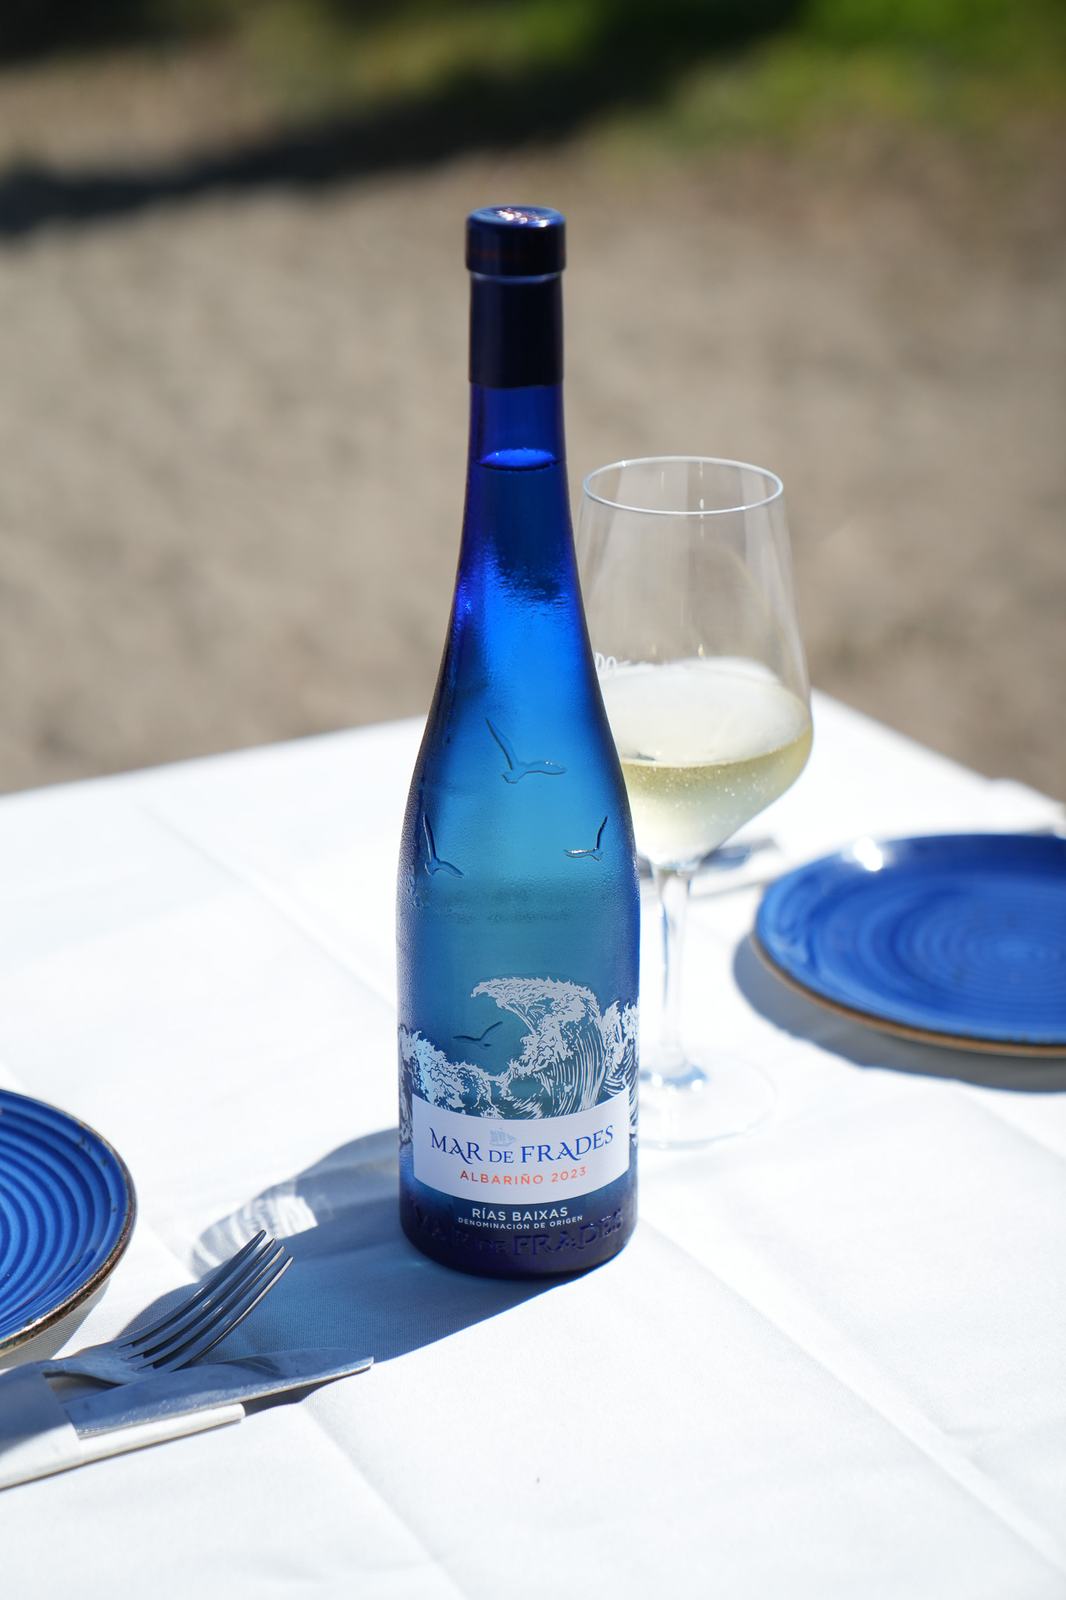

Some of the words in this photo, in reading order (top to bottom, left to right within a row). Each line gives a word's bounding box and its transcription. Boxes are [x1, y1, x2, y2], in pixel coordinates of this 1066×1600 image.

[429, 1127, 484, 1165] MAR
[488, 1150, 515, 1164] DE
[520, 1124, 614, 1164] FRADES
[459, 1170, 544, 1186] ALBARIÑO
[551, 1165, 587, 1183] 2023
[472, 1207, 507, 1221] RÍAS
[512, 1206, 568, 1222] BAIXAS
[533, 1222, 546, 1230] DE
[549, 1215, 584, 1228] ORIGEN
[513, 1208, 623, 1256] FRADES
